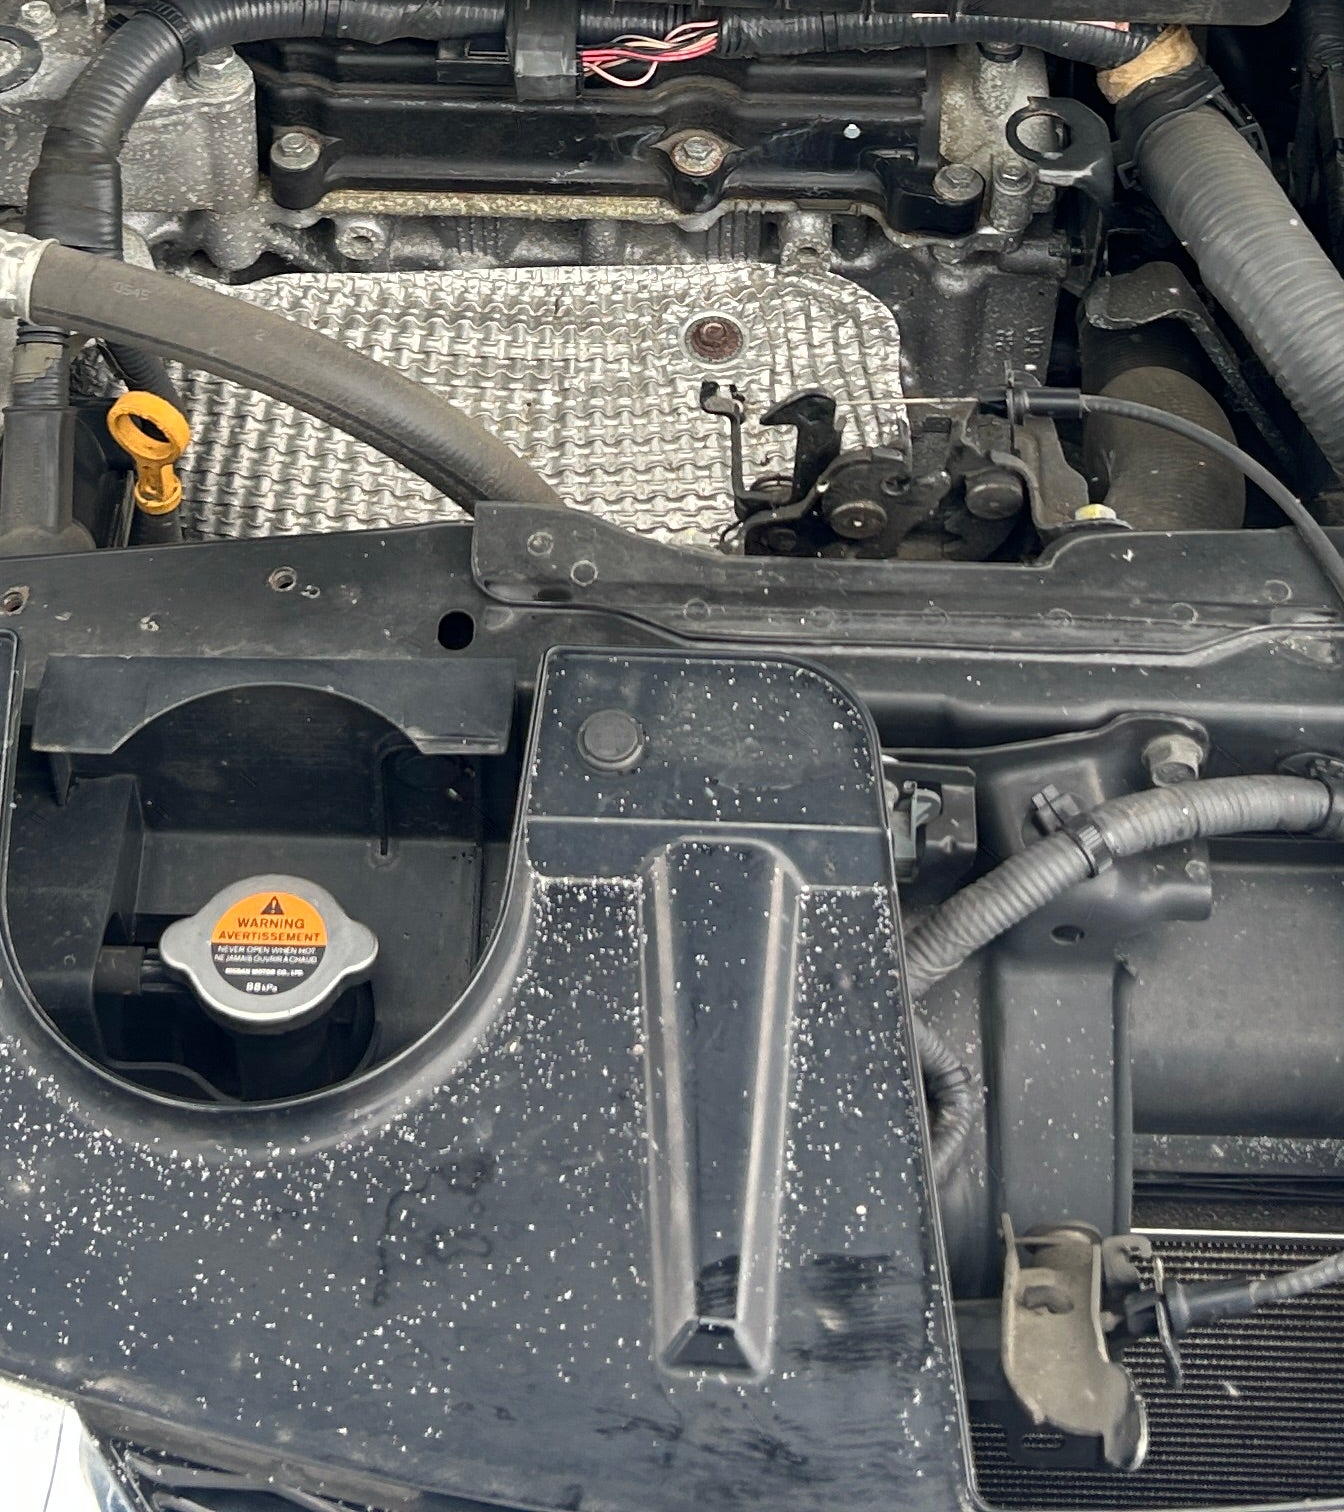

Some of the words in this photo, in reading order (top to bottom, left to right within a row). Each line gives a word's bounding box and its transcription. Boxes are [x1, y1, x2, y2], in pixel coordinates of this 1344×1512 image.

[237, 917, 305, 929] WARNING
[218, 930, 321, 942] AVERTISSEMENT
[217, 945, 245, 953] NEVER
[247, 946, 270, 954] OPEN
[271, 946, 297, 954] WHEN
[214, 953, 225, 961] NE
